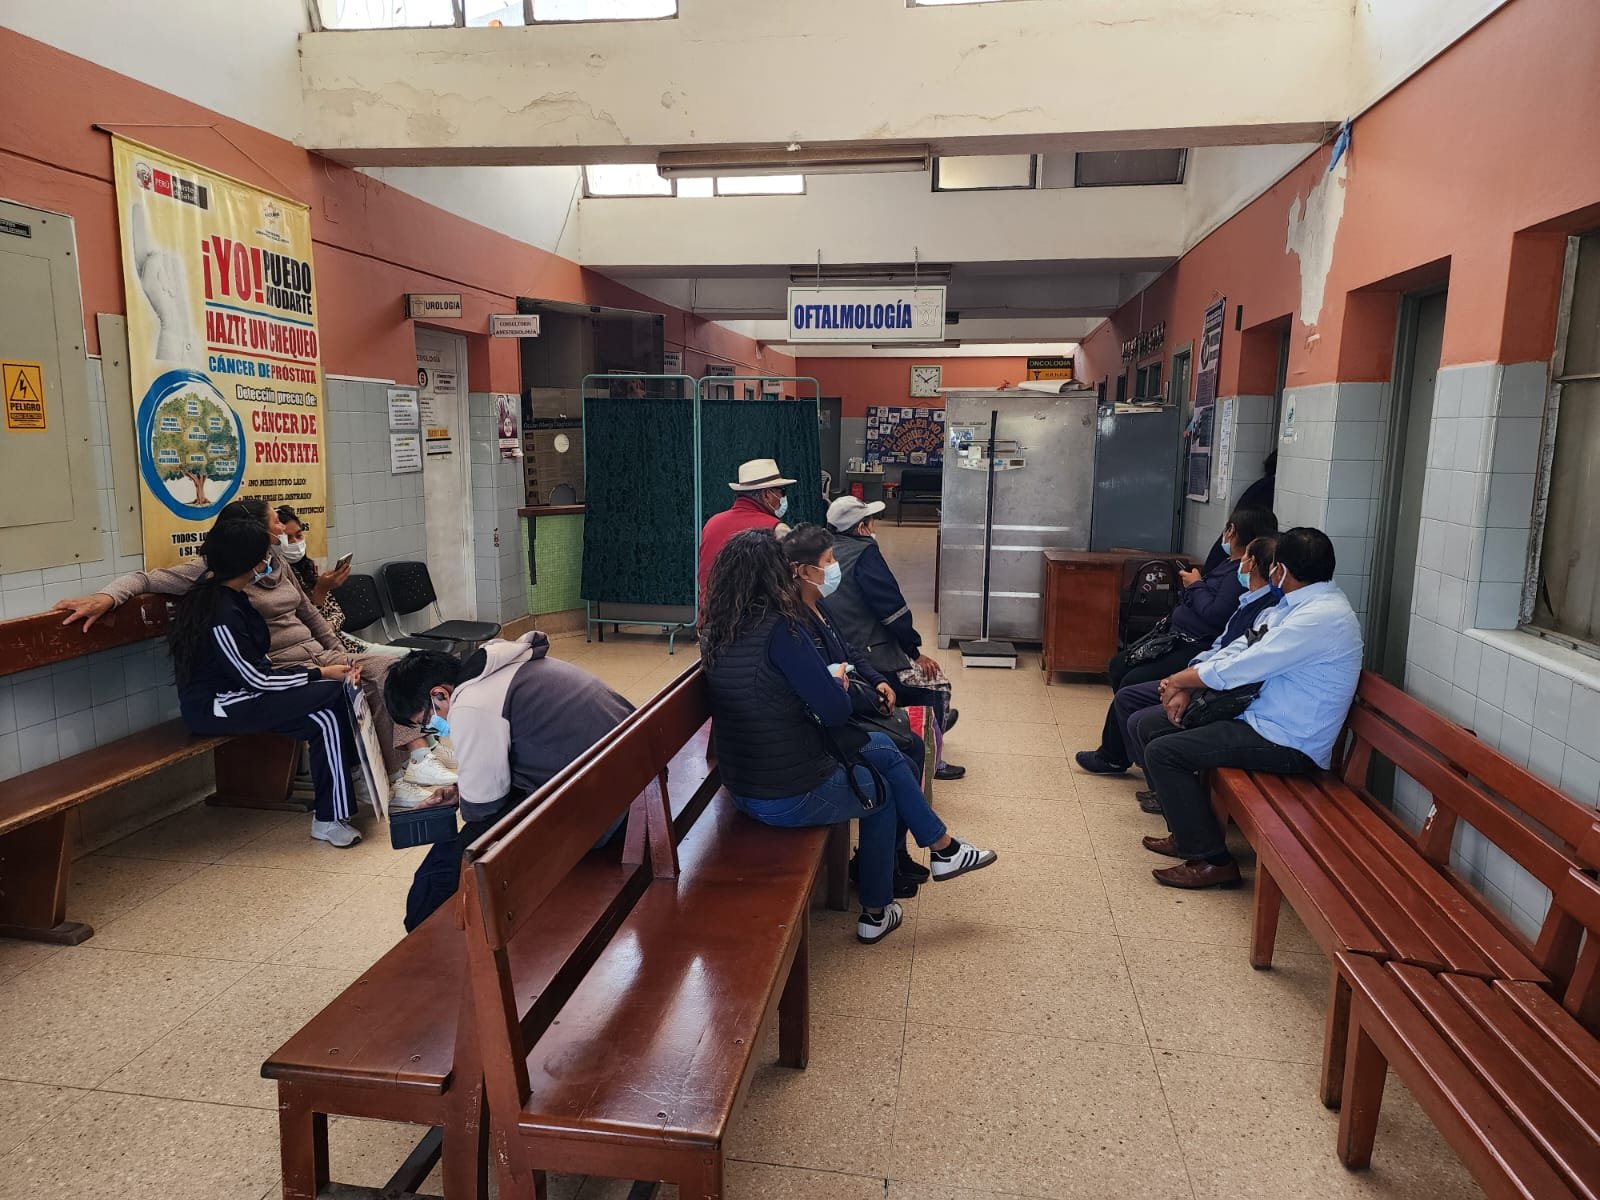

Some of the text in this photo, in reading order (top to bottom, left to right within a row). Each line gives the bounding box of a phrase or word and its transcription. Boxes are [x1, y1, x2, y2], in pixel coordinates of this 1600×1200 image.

[201, 234, 264, 304] ¡YO!
[262, 249, 312, 294] PUEDO
[266, 287, 312, 315] AYUDARTE
[425, 301, 460, 310] UROLOGIA
[793, 298, 912, 329] OFTALMOLOGÍA
[205, 310, 318, 359] HAZTE UN CHEQUEO
[208, 354, 317, 385] CÁNCER DE PRÓSTATA
[10, 402, 41, 411] PELIGRO
[277, 391, 304, 406] precoz
[252, 405, 317, 434] CÁNCER DE
[255, 436, 319, 464] PRÓSTATA
[172, 532, 198, 544] TODOS
